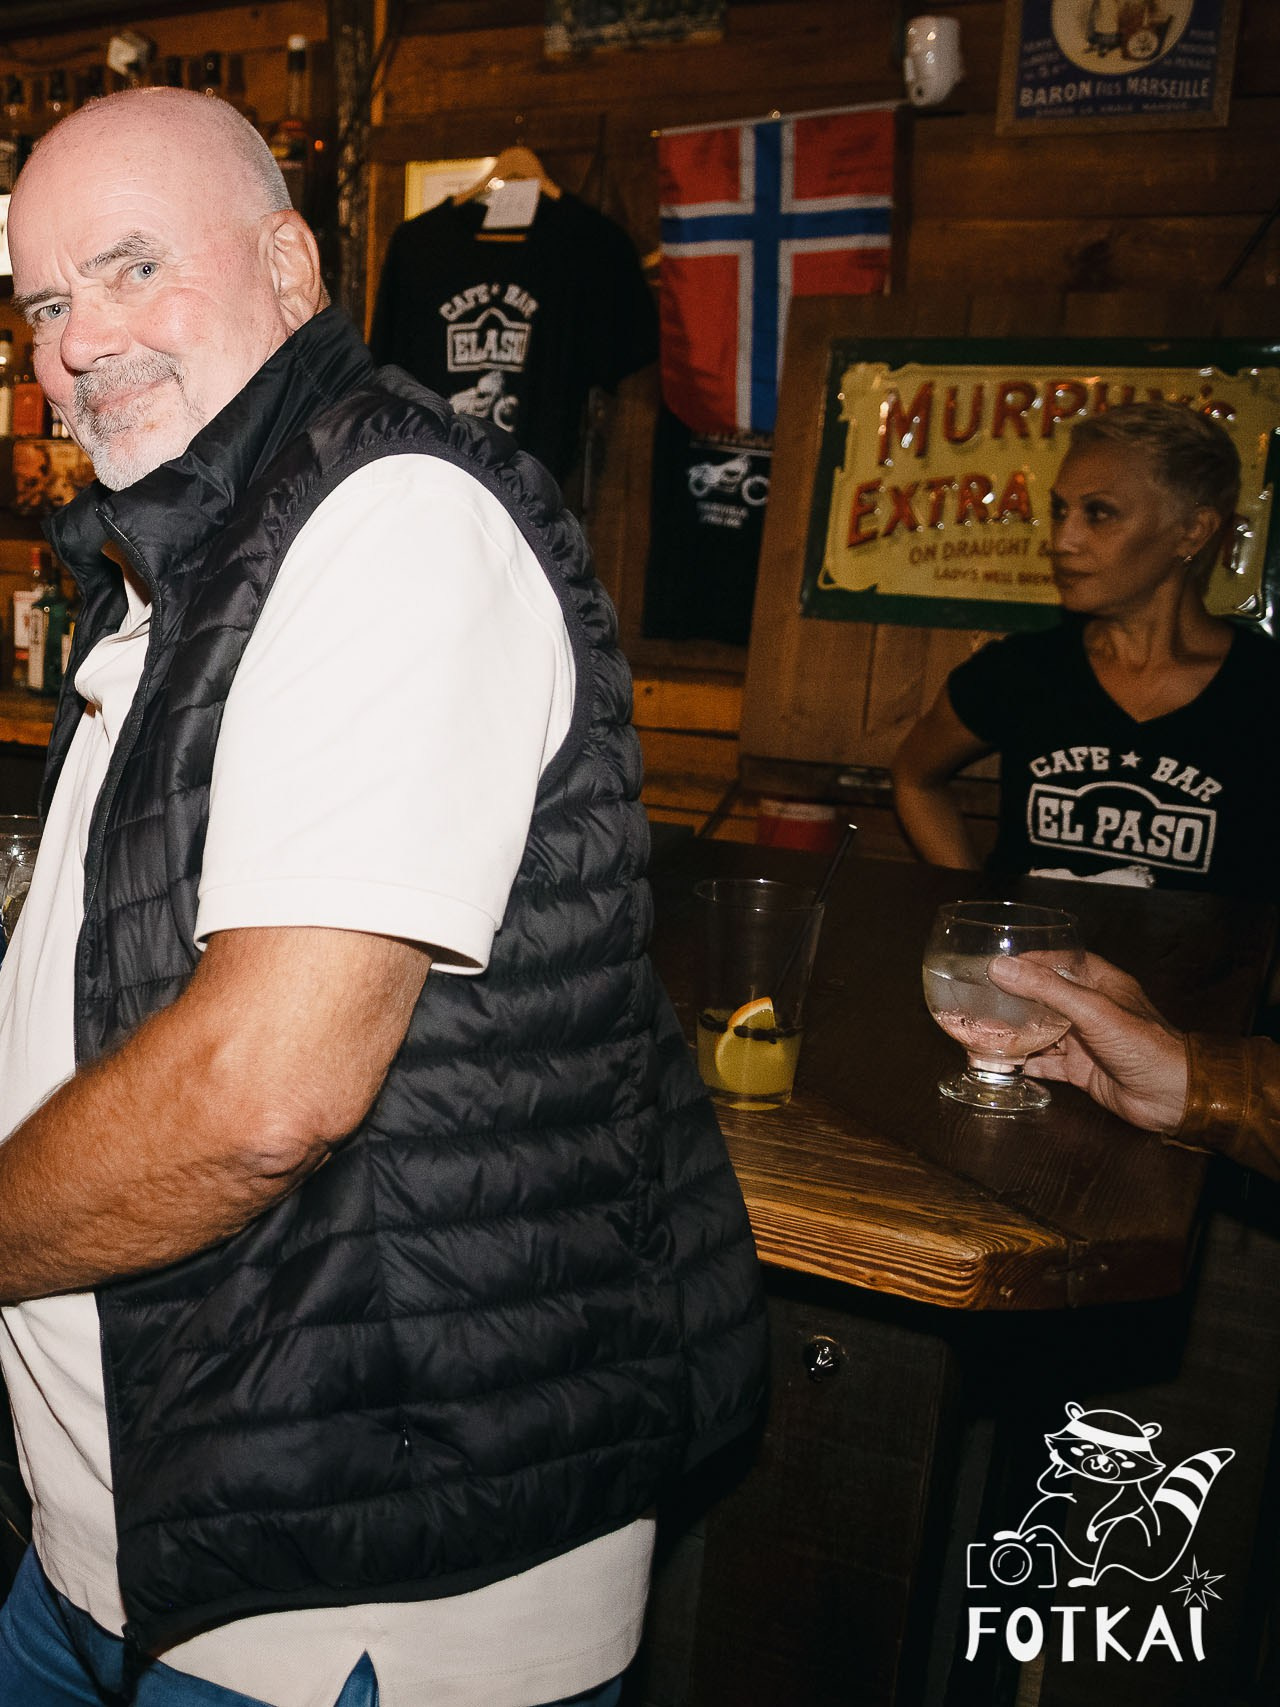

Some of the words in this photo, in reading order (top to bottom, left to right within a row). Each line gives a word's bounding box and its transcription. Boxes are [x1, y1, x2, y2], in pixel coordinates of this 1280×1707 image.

[1019, 80, 1092, 107] BARON
[1126, 77, 1211, 99] MARSEILLE
[847, 470, 1038, 547] EXTRA
[908, 544, 938, 566] ON
[941, 538, 1031, 562] DRAUGHT
[1029, 746, 1110, 778] CAFE
[1151, 756, 1223, 802] BAR
[1037, 796, 1084, 842] EL
[1092, 806, 1204, 862] PASO
